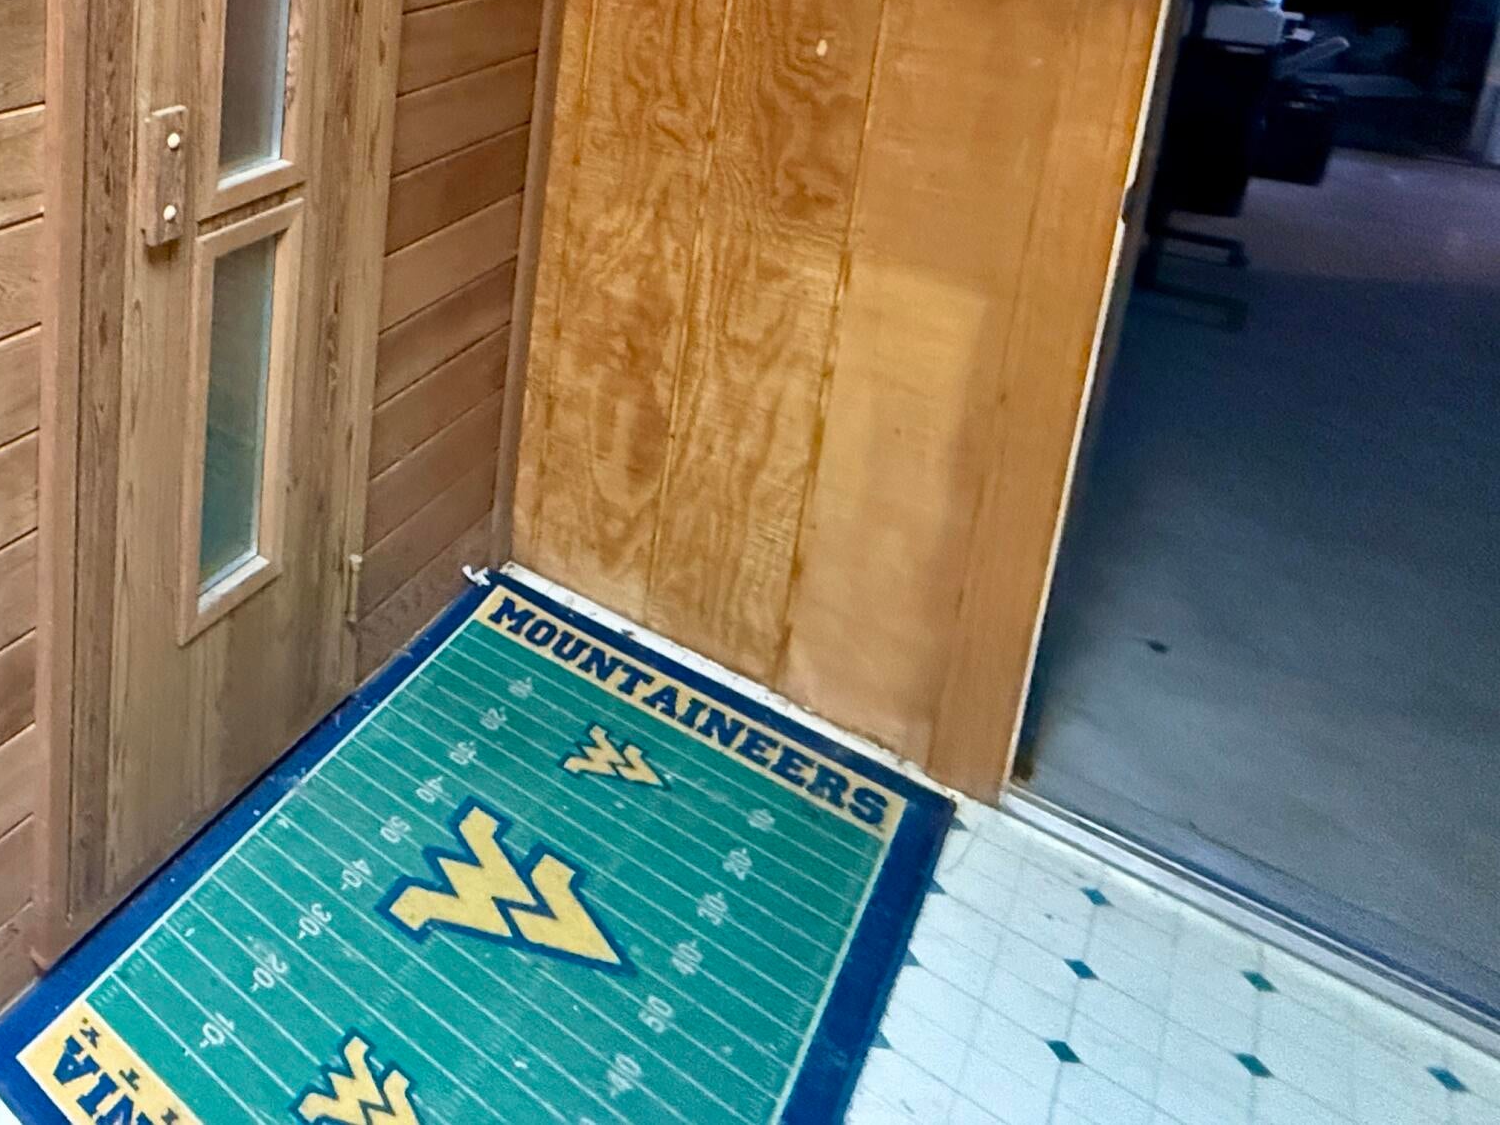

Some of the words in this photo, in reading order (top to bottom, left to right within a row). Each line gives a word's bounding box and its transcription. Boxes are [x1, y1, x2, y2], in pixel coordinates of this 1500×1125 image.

[487, 595, 889, 826] MOUNTAINEERS
[342, 859, 373, 888] 40
[299, 903, 332, 937] 30
[253, 954, 288, 989] 20
[202, 1012, 235, 1046] 10
